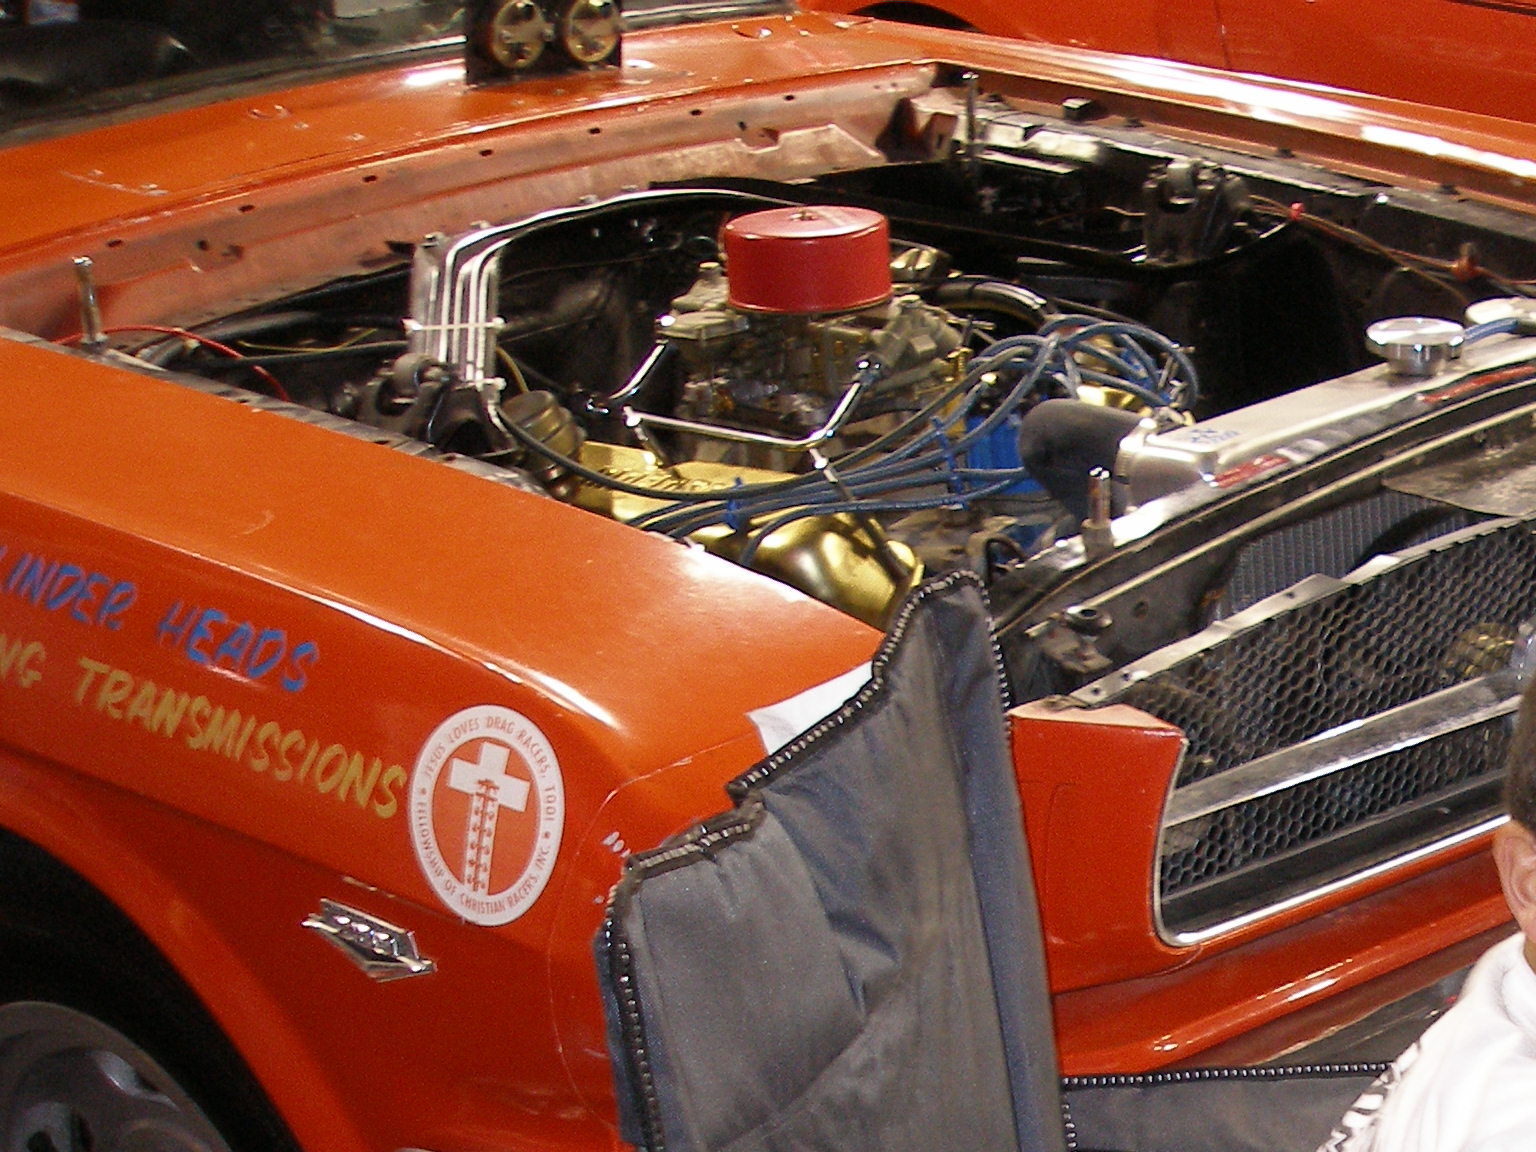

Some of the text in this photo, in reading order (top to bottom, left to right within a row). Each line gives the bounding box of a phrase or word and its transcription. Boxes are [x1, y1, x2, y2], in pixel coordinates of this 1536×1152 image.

[157, 600, 319, 692] HEADS
[74, 656, 408, 819] TRANSMISSIONS
[424, 743, 447, 780] JESUS
[447, 716, 481, 744] LOVES
[485, 715, 514, 734] DRAG
[443, 878, 458, 896] OF
[459, 892, 506, 915] CHRISTIAN
